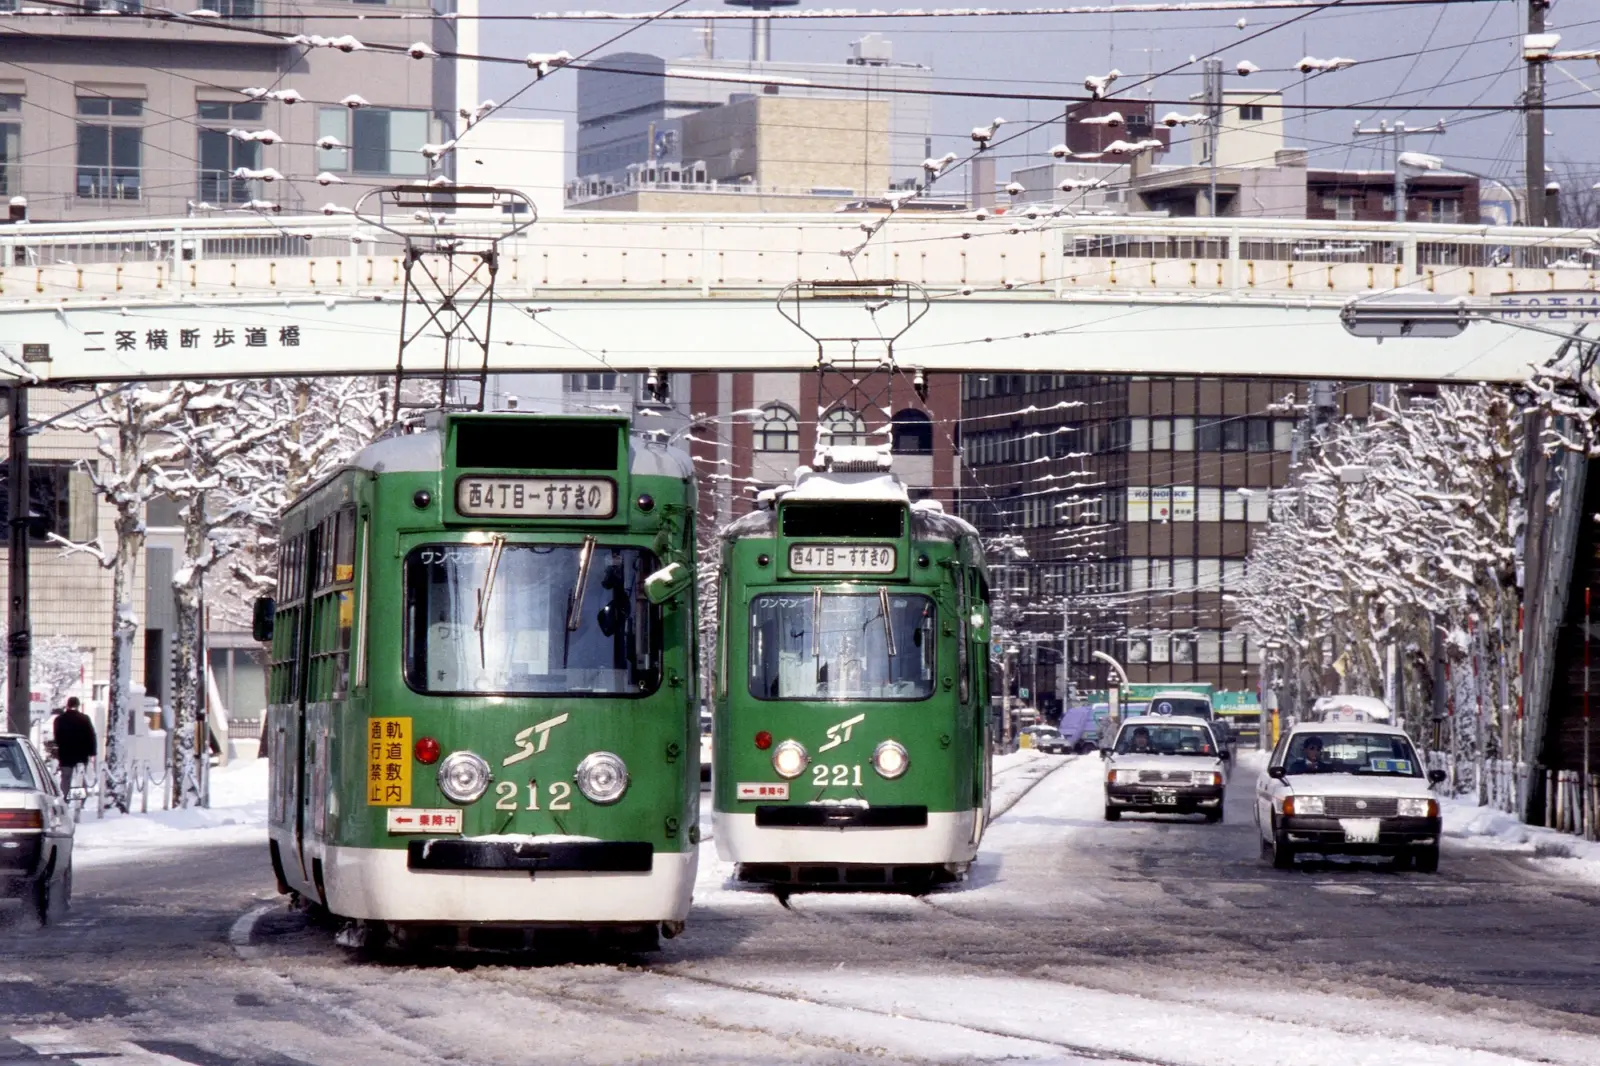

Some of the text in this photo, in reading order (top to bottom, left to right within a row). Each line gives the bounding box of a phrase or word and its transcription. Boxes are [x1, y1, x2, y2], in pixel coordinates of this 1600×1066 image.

[83, 325, 302, 352] 二条横断歩道橋
[544, 483, 602, 510] すすきの
[849, 547, 889, 566] すすきの
[759, 598, 799, 609] ワンマン
[370, 721, 382, 802] 通行禁止
[385, 721, 403, 802] 軌道敷内
[812, 764, 863, 786] 221
[495, 780, 572, 811] 212
[419, 814, 457, 827] 乗降中
